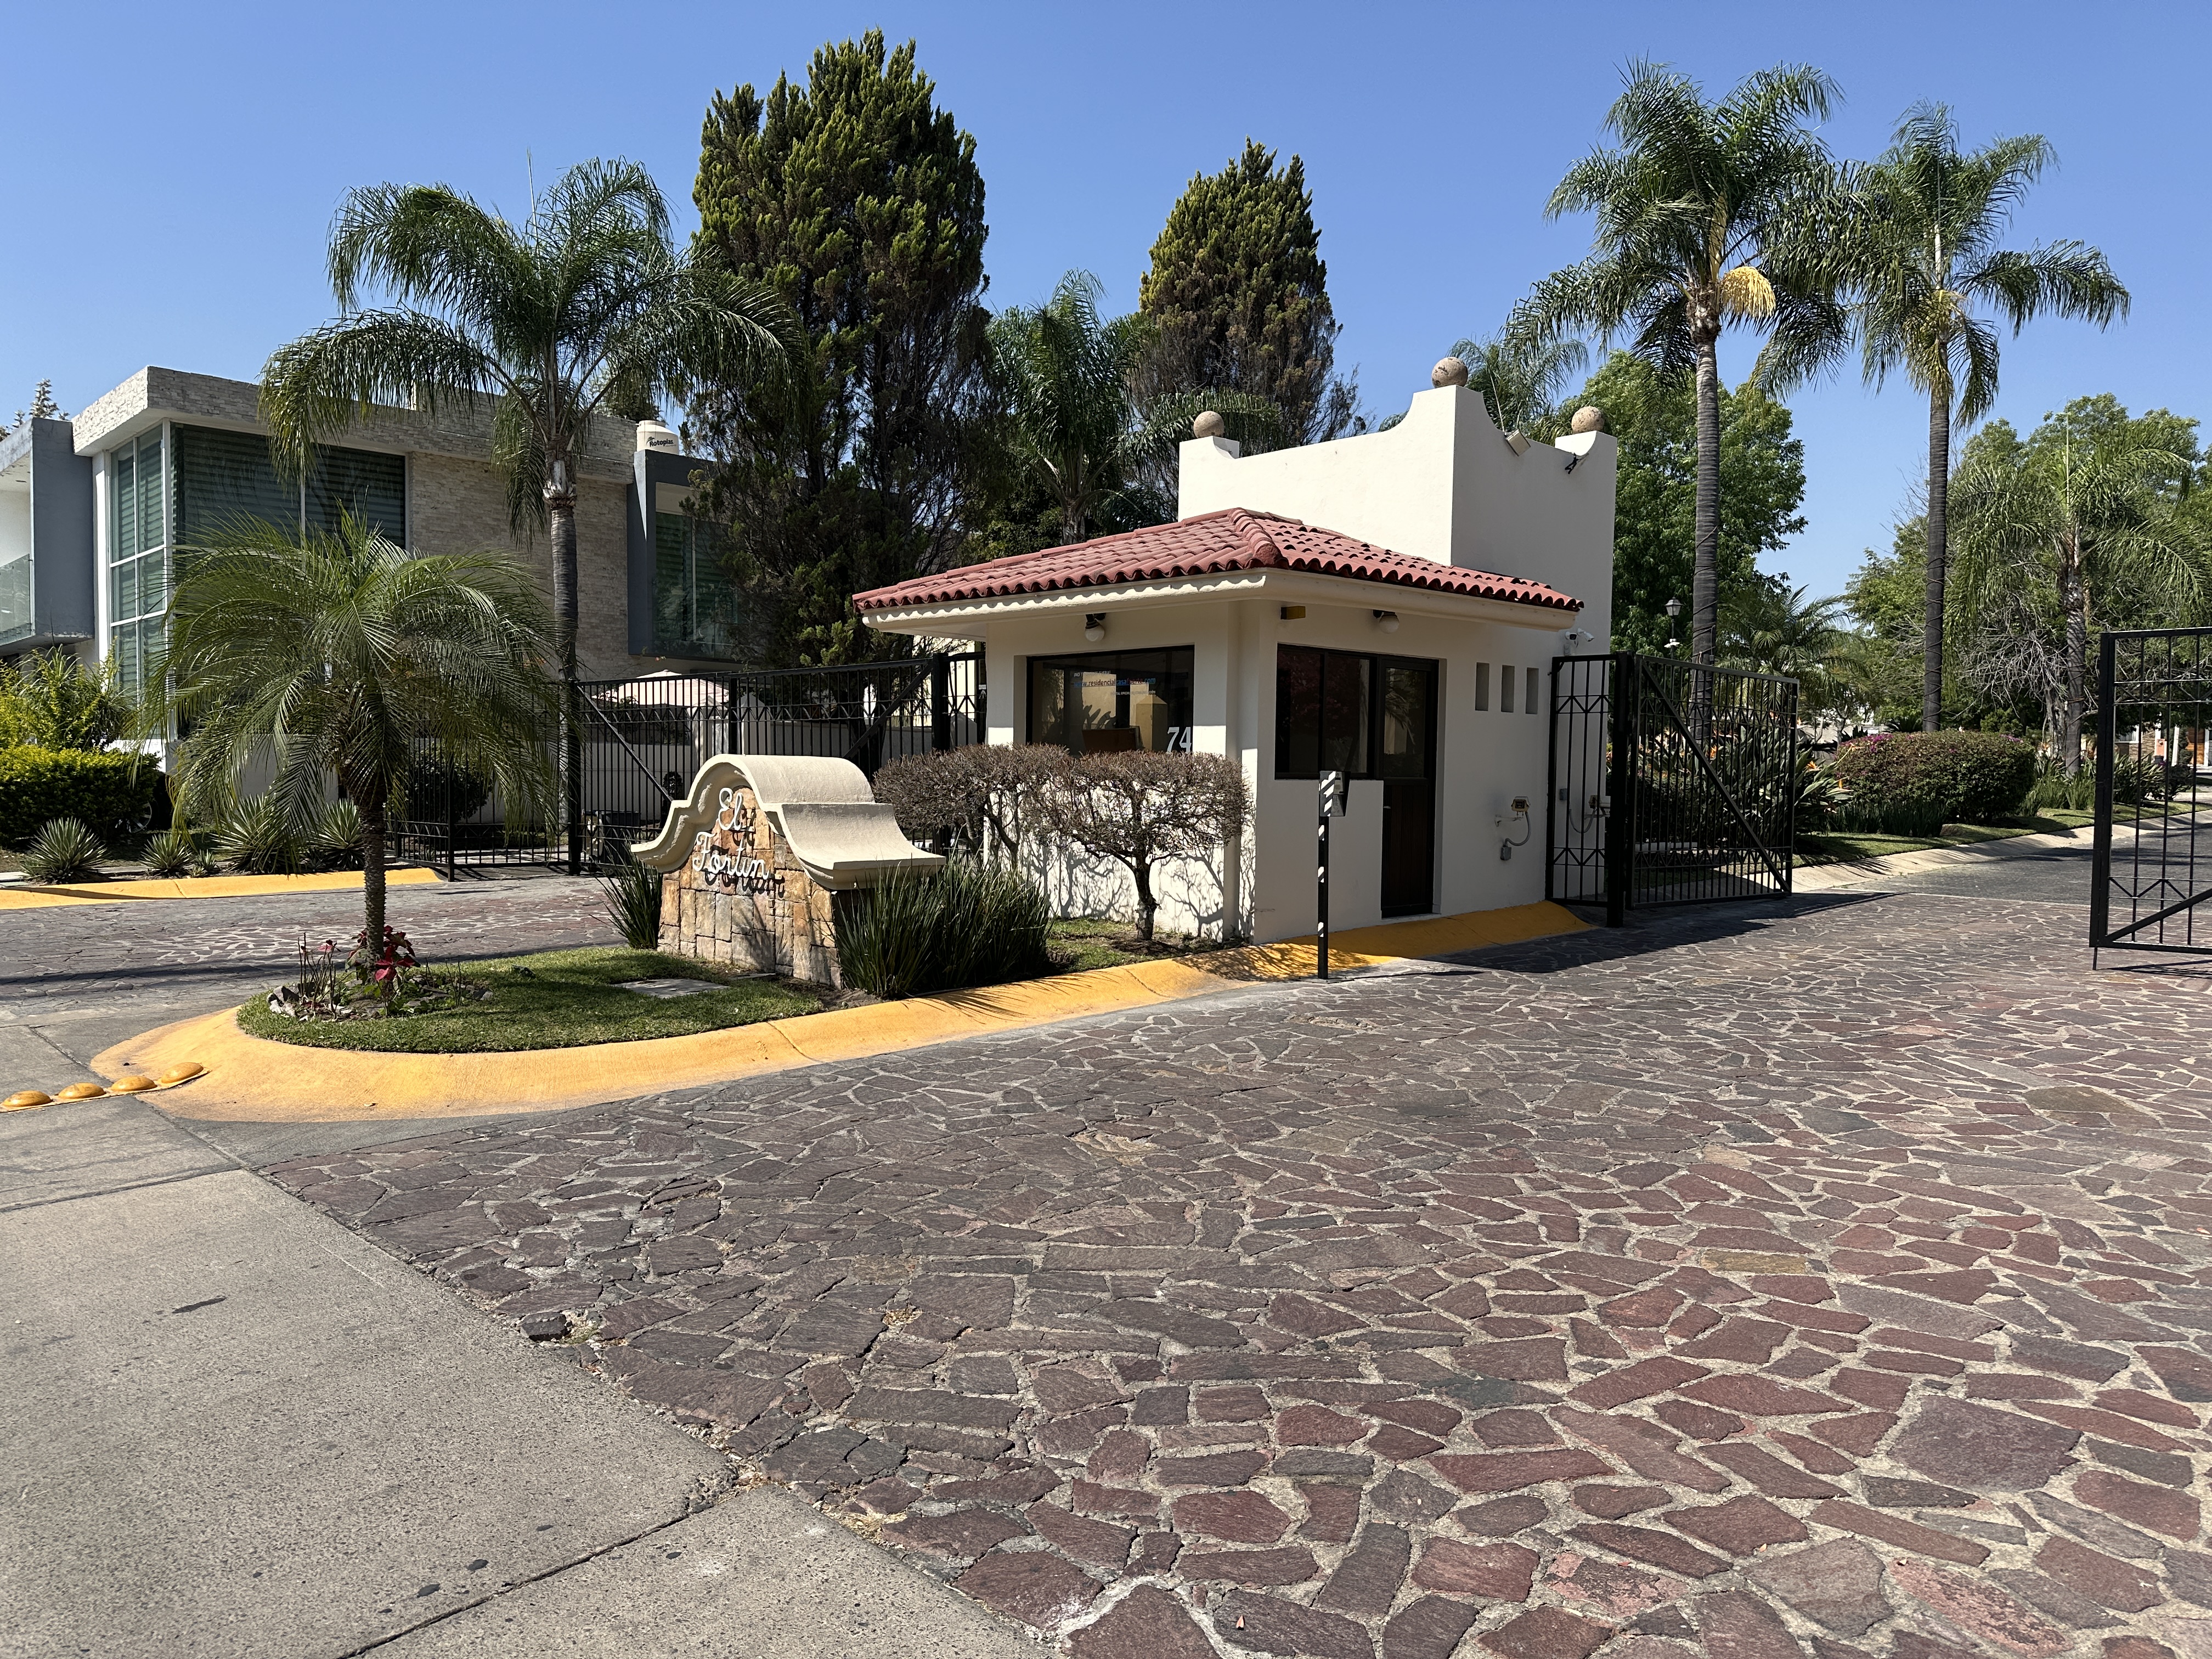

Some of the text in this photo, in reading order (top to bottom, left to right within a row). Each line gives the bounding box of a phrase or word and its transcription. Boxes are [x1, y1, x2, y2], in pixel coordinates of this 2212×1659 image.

[650, 438, 673, 447] Rotoplas
[1166, 726, 1192, 754] 74
[718, 787, 743, 831] El
